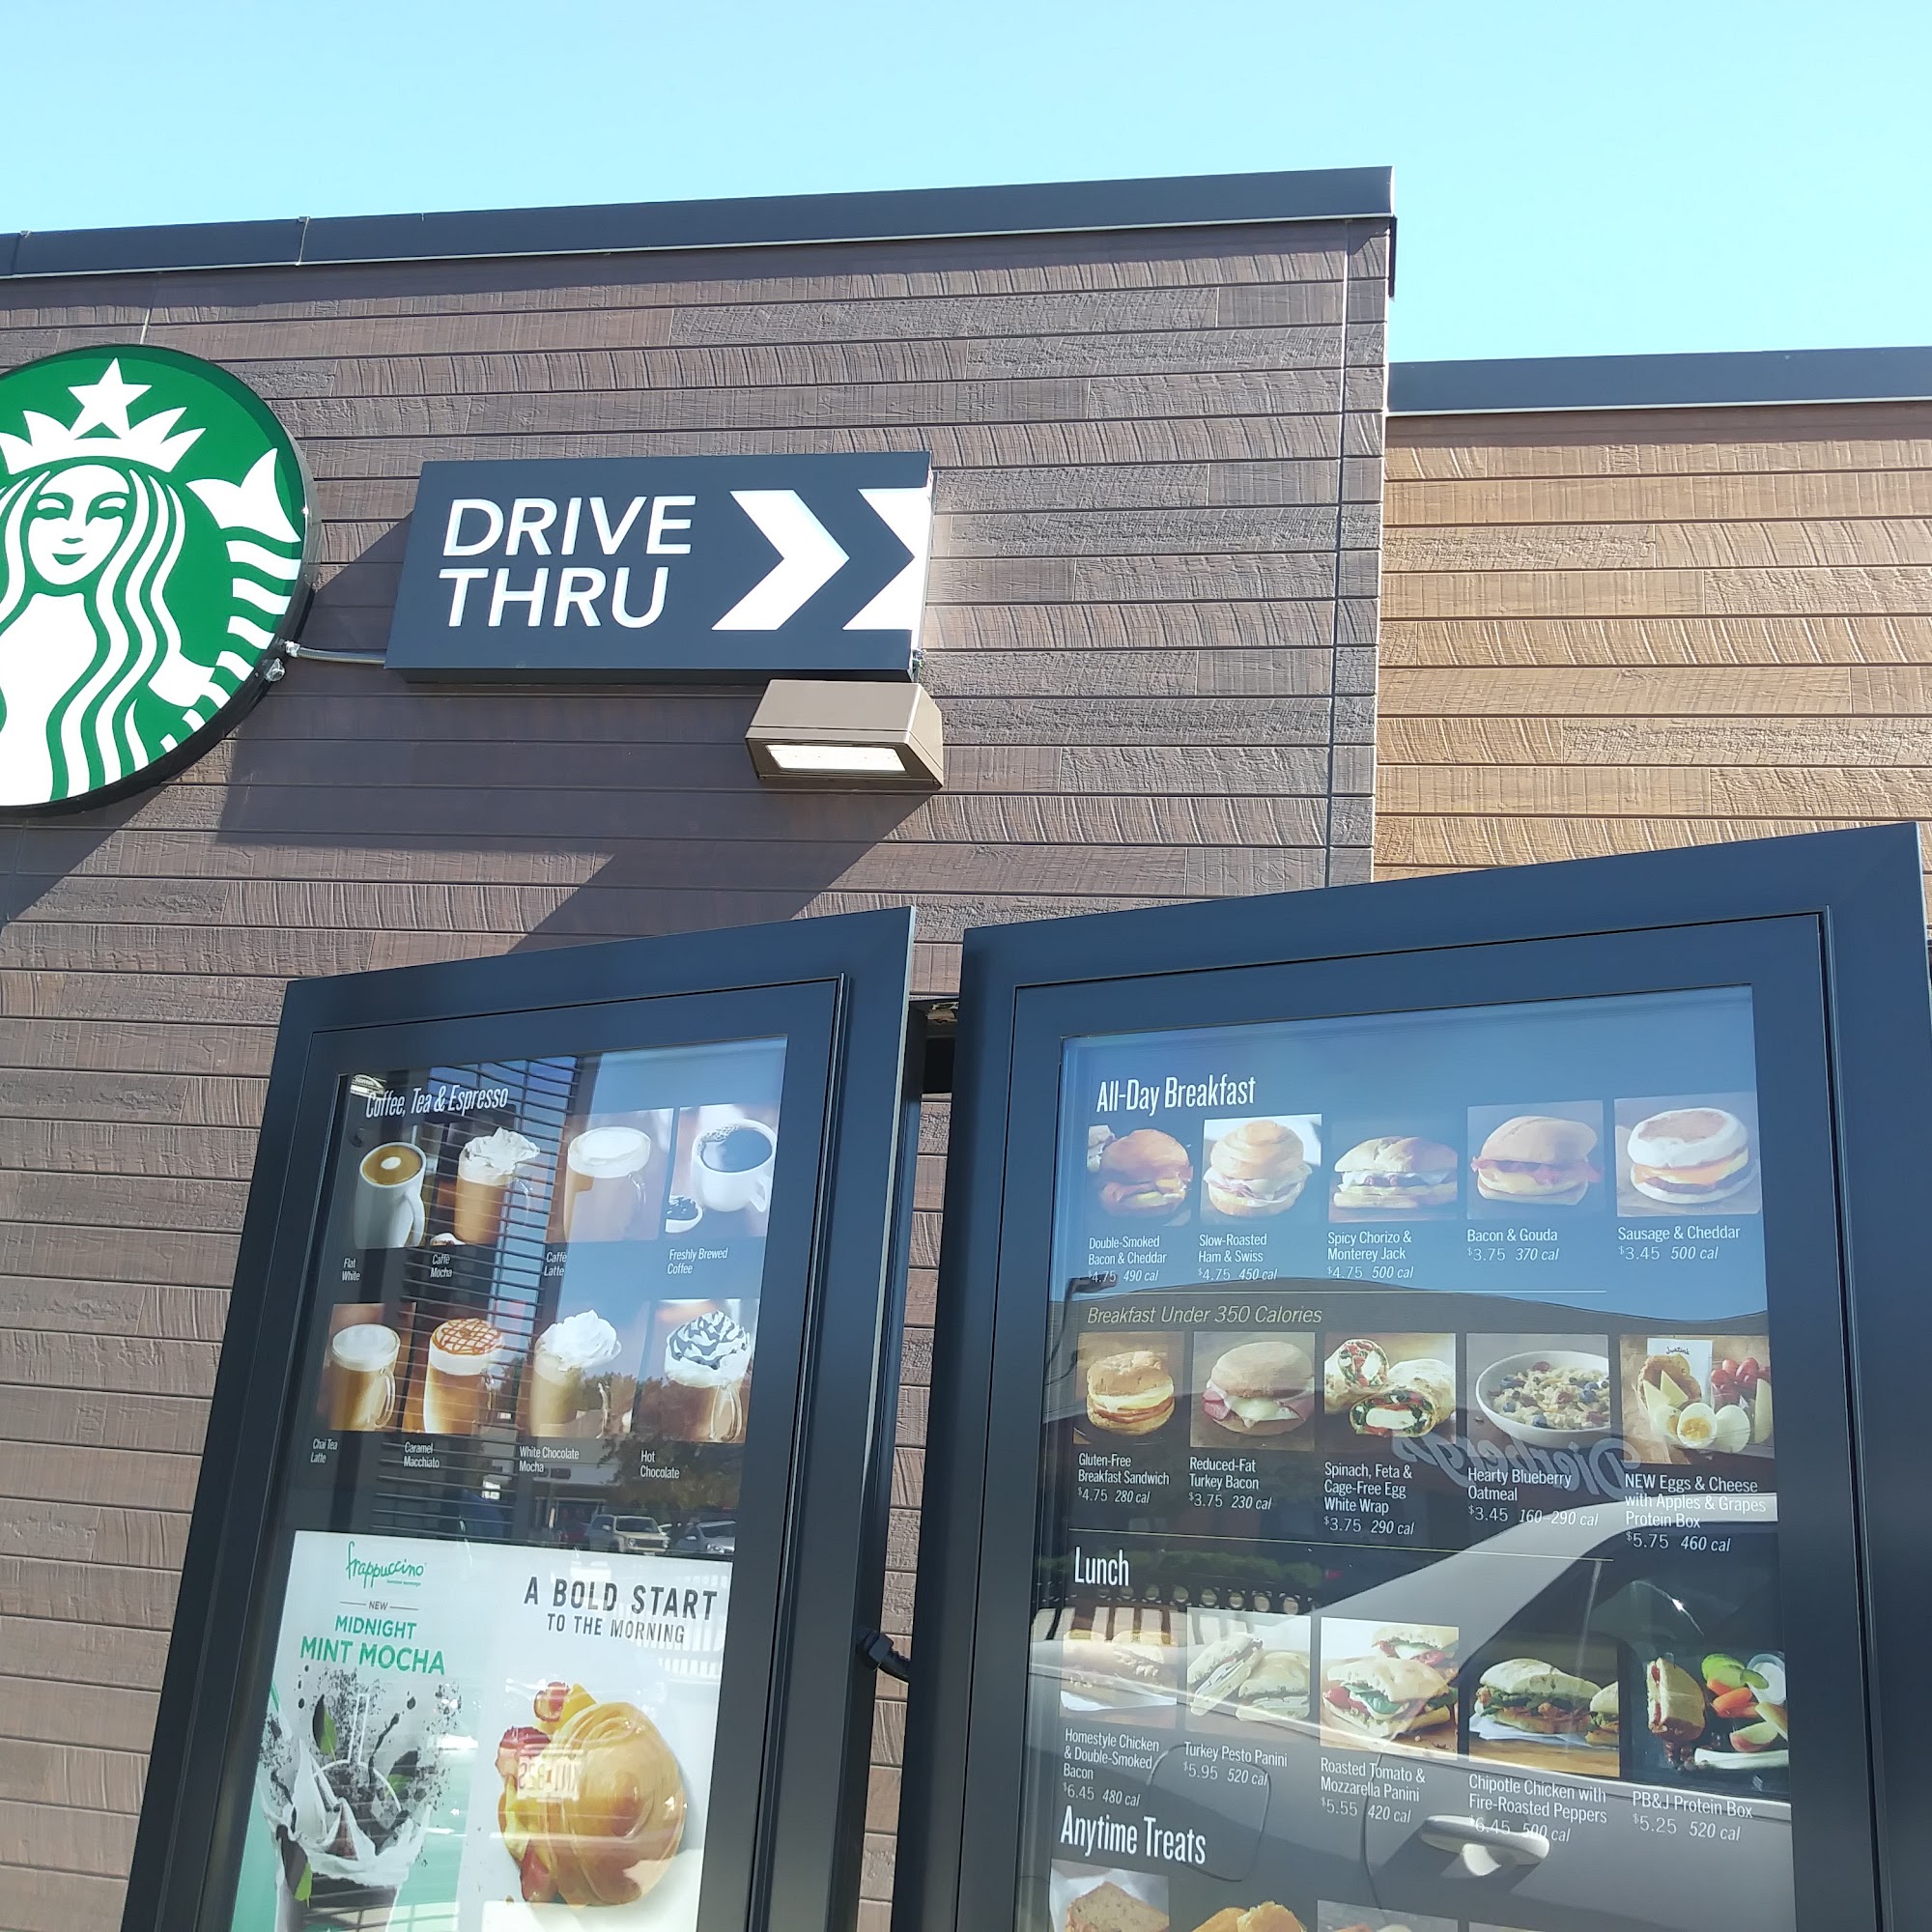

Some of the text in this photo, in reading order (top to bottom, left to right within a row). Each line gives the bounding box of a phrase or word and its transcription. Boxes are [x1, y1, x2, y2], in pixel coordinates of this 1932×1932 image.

[442, 496, 696, 556] DRIVE
[439, 566, 669, 628] THRU
[366, 1085, 509, 1118] Coffee, Tea & Espresso
[1096, 1074, 1256, 1116] All-Day Breakfast
[1199, 1234, 1267, 1246] Slow-Roasted
[1328, 1231, 1411, 1246] Spicy Chorizo &
[1467, 1228, 1557, 1241] Bacon & Gouda
[1618, 1225, 1740, 1243] Sausage & Cheddar
[1090, 1236, 1159, 1251] Double-Smoked
[669, 1248, 728, 1262] Freshly Brewed
[1089, 1252, 1167, 1265] Bacon & Cheddar
[1199, 1250, 1264, 1263] Ham & Swiss
[1328, 1247, 1406, 1263] Monterey Jack
[1466, 1247, 1559, 1262] $3.75 370 cal
[1618, 1245, 1719, 1260] $3.45 500 cal
[344, 1258, 355, 1268] Flat
[544, 1265, 564, 1276] Latte
[668, 1264, 693, 1274] Coffee
[342, 1270, 360, 1281] White
[431, 1267, 452, 1277] Mocha
[1123, 1269, 1142, 1282] 490
[1145, 1269, 1159, 1282] cal
[1198, 1267, 1277, 1280] $4.75 450 cal
[1327, 1265, 1413, 1279] $4.75 500 cal
[1088, 1305, 1322, 1323] Breakfast Under 350 Calories
[313, 1438, 337, 1450] Chai Tea
[405, 1442, 433, 1453] Caramel
[310, 1452, 326, 1463] Latte
[520, 1446, 579, 1459] White Chocolate
[641, 1451, 655, 1463] Hot
[1079, 1453, 1131, 1467] Gluten-Free
[404, 1456, 440, 1468] Macchiato
[520, 1461, 544, 1472] Mocha
[1190, 1457, 1256, 1472] Reduced-Fat
[640, 1465, 680, 1479] Chocolate
[1078, 1469, 1169, 1485] Breakfast Sandwich
[1324, 1463, 1412, 1479] Spinach, Feta &
[1468, 1468, 1572, 1488] Hearty Blueberry
[1189, 1473, 1259, 1490] Turkey Bacon
[1324, 1480, 1406, 1498] Cage-Free Egg
[1625, 1473, 1758, 1492] NEW Eggs & Cheese
[1078, 1487, 1151, 1503] $4.75 280 cal
[1189, 1492, 1272, 1510] $3.75 230 cal
[1468, 1488, 1518, 1502] Oatmeal
[1324, 1498, 1389, 1516] White Wrap
[1625, 1493, 1766, 1514] with Apples & Grapes
[1468, 1505, 1508, 1522] $3.45
[1579, 1511, 1599, 1526] cal
[1626, 1512, 1700, 1528] Protein Box
[1323, 1516, 1414, 1535] $3.75 290 cal
[1626, 1531, 1731, 1551] $5.75 460 cal
[1074, 1547, 1130, 1586] Lunch
[369, 1601, 388, 1609] NEW
[524, 1577, 718, 1620] A BOLD START
[335, 1615, 417, 1639] MIDNIGHT
[548, 1613, 685, 1643] TO THE MORNING
[300, 1635, 444, 1675] MINT MOCHA
[1065, 1728, 1159, 1751] Homestyle Chicken
[1065, 1747, 1152, 1769] & Double-Smoked
[1184, 1742, 1288, 1768] Turkey Pesto Panini
[1064, 1763, 1094, 1779] Bacon
[1183, 1761, 1268, 1786] $5.95 520 cal
[1321, 1758, 1425, 1782] Roasted Tomato &
[1063, 1782, 1141, 1806] $6.45 480 cal
[1321, 1776, 1420, 1802] Mozzarella Panini
[1469, 1774, 1606, 1804] Chipotle Chicken with
[1321, 1796, 1411, 1824] $5.55 420 cal
[1469, 1794, 1607, 1824] Fire-Roasted Peppers
[1633, 1790, 1752, 1818] PB&J Protein Box
[1061, 1805, 1206, 1864] Anytime Treats
[1550, 1826, 1571, 1842] cal
[1633, 1813, 1741, 1841] $5.25 520 cal
